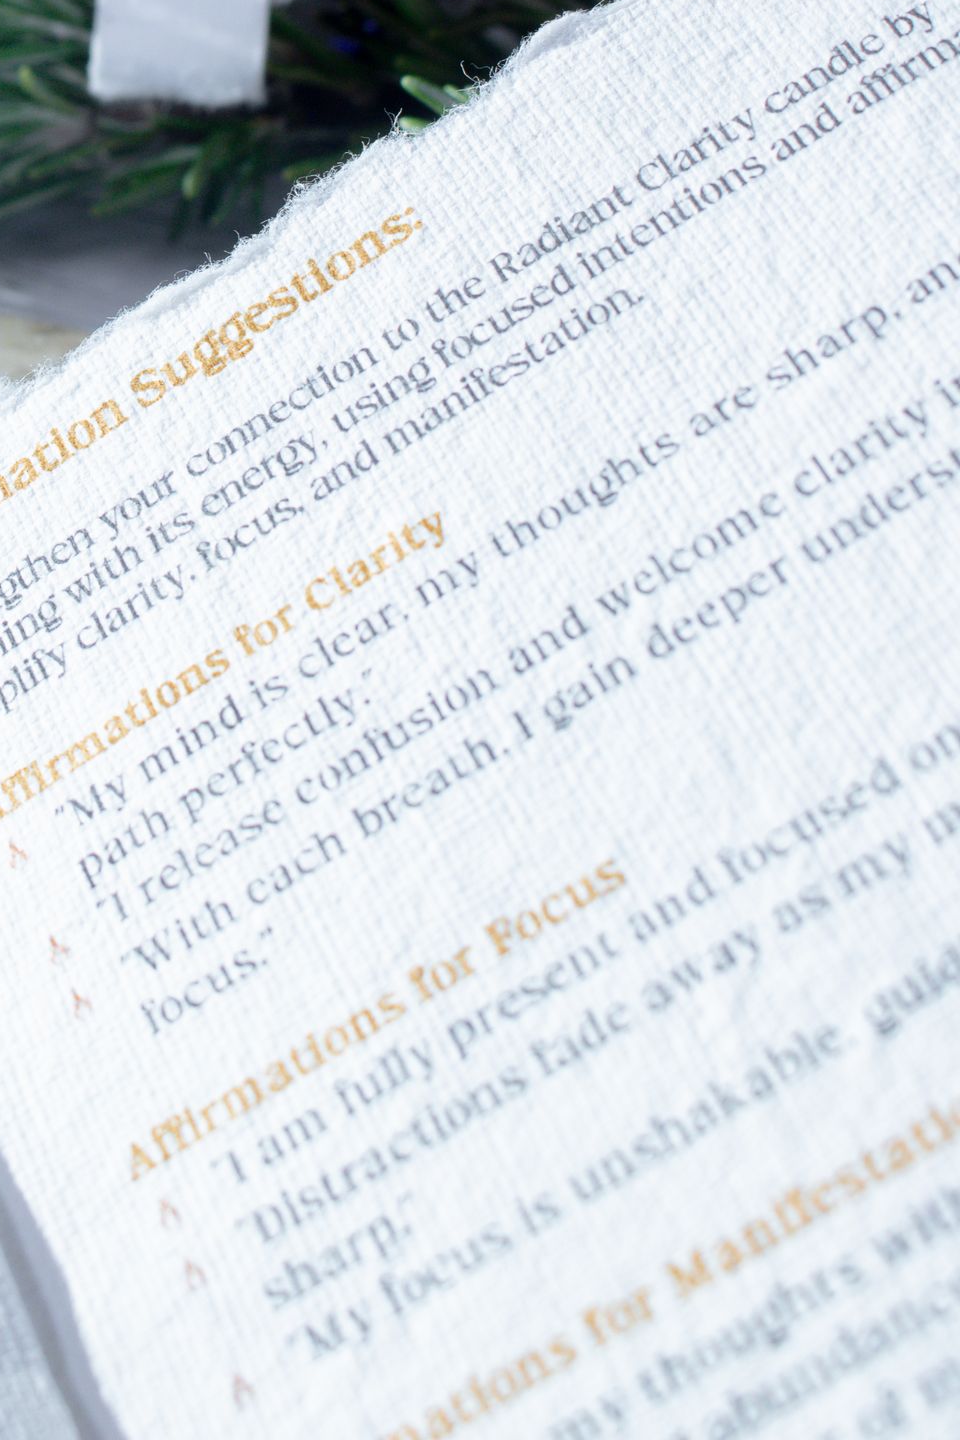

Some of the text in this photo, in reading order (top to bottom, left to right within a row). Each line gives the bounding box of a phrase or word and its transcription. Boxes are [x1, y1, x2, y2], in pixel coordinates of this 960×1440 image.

[62, 543, 145, 605] with
[146, 510, 196, 551] its
[201, 428, 329, 518] energy,
[331, 356, 437, 433] using
[430, 270, 577, 361] focused
[576, 153, 768, 279] intentions
[770, 102, 843, 163] and
[847, 31, 960, 114] affirm
[97, 469, 178, 537] your
[186, 346, 379, 477] connection
[382, 318, 420, 351] to
[424, 273, 486, 324] the
[487, 184, 635, 285] Radiant
[636, 106, 759, 192] Clarity
[764, 34, 885, 114] candle
[881, 2, 935, 38] by
[130, 207, 424, 408] Suggestions:
[310, 439, 380, 503] and
[383, 286, 645, 455] manifestation.
[139, 695, 244, 782] mind
[248, 672, 289, 711] is
[415, 551, 480, 608] my
[489, 431, 681, 559] thoughts
[688, 384, 759, 440] are
[139, 799, 285, 905] release
[294, 666, 500, 806] confusion
[507, 605, 590, 675] and
[595, 492, 786, 619] welcome
[793, 401, 929, 498] clarity
[235, 603, 296, 658] for
[304, 510, 445, 611] Clarity
[77, 809, 171, 890] path
[246, 828, 347, 904] each
[513, 709, 536, 742] I
[542, 653, 639, 732] gain
[645, 553, 790, 661] deeper
[128, 857, 628, 1181] Affirmations for Focus
[256, 1102, 329, 1168] am
[334, 1037, 434, 1118] fully
[447, 932, 620, 1060] present
[627, 866, 718, 944] and
[716, 758, 904, 884] focused
[529, 1000, 632, 1080] fade
[641, 924, 762, 1015] away
[772, 885, 832, 934] as
[837, 830, 913, 897] my
[379, 1222, 514, 1318] focus
[517, 1190, 564, 1238] is
[583, 1286, 655, 1347] for
[638, 1256, 863, 1402] thoughts
